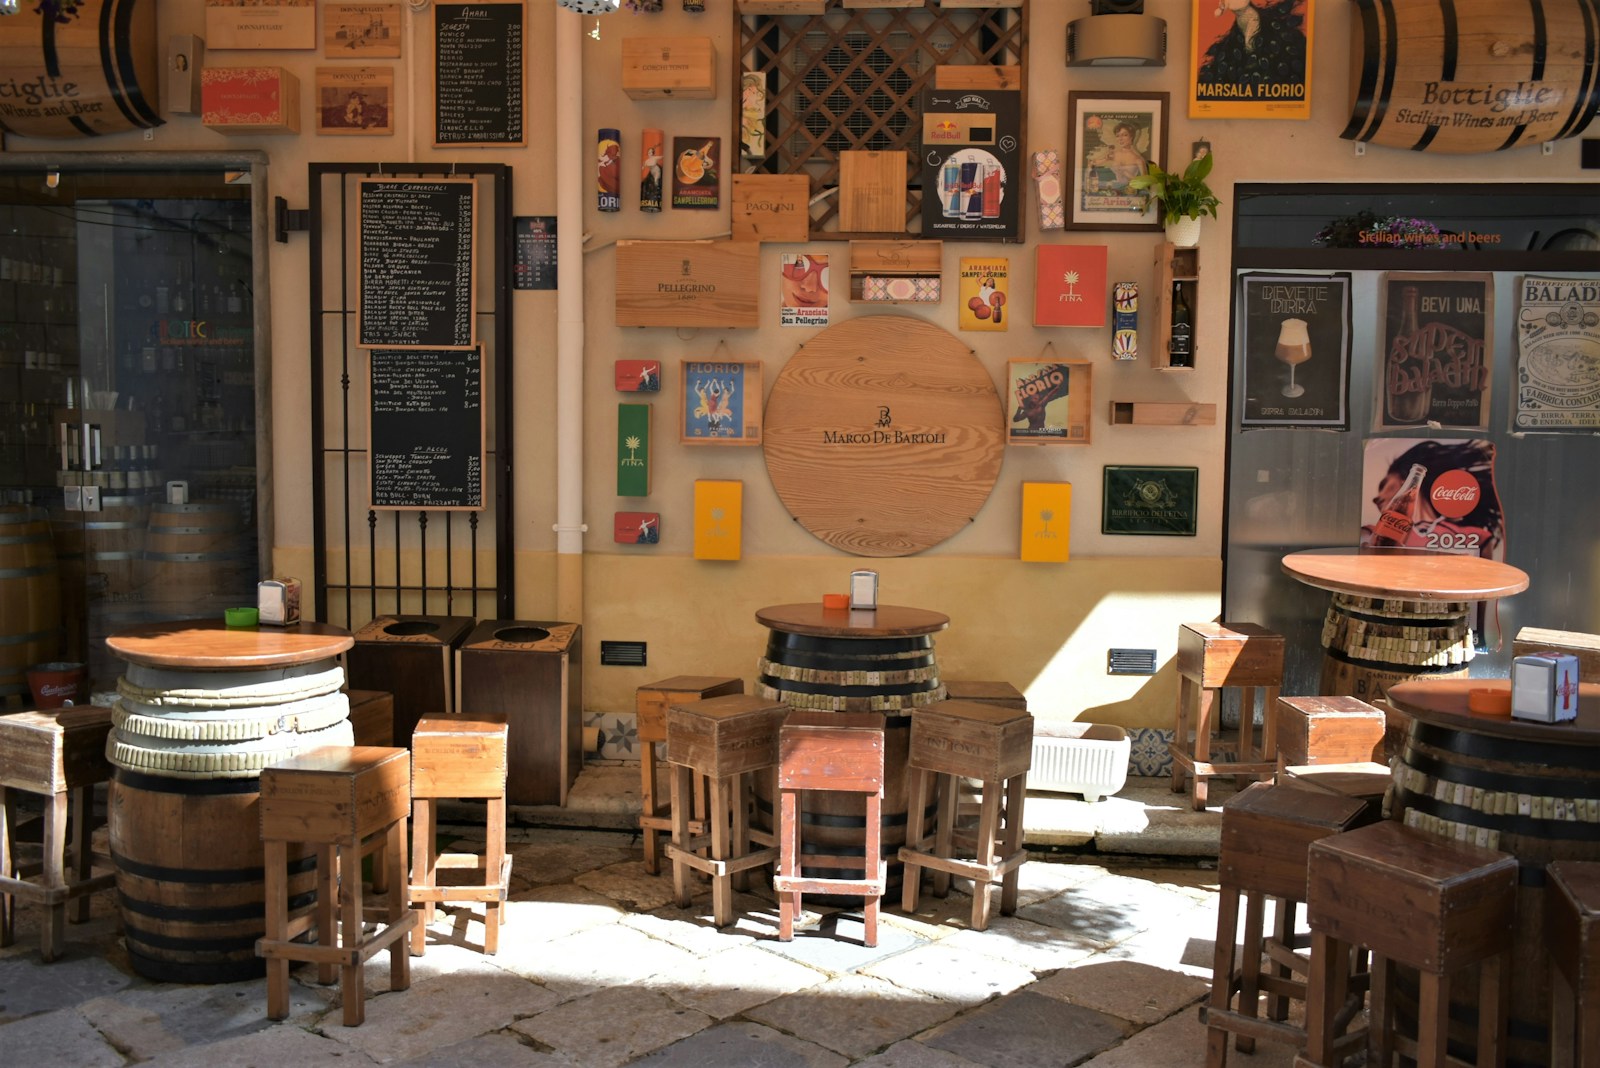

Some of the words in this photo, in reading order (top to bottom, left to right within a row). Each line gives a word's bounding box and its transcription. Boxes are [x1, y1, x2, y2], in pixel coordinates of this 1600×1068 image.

[462, 6, 488, 19] AMARI
[441, 23, 470, 31] SEGESTA
[1198, 83, 1253, 97] MARSALA
[1258, 83, 1304, 97] FLORIO
[1422, 81, 1554, 112] Bottiglie
[43, 100, 70, 116] and
[71, 100, 102, 114] Beer
[1396, 108, 1450, 126] Sicilian
[1453, 112, 1494, 128] Wines
[1498, 110, 1522, 126] and
[1526, 108, 1560, 125] Beer
[440, 132, 465, 140] PETRUS
[746, 202, 794, 212] PAOLINI
[1358, 230, 1402, 243] Sicilian
[1442, 230, 1465, 243] and
[1468, 230, 1501, 243] beers
[658, 283, 716, 293] PELLEGRINO
[797, 308, 828, 316] Aranciata
[1421, 297, 1450, 313] BEVI
[1456, 298, 1480, 314] UNA
[782, 316, 793, 324] San
[795, 316, 828, 326] Pellegrino
[690, 364, 740, 374] FLORIO
[1526, 389, 1564, 406] FABBRICA
[824, 431, 870, 443] MARCO
[874, 431, 891, 443] DE
[895, 431, 945, 444] BARTOLI
[1432, 486, 1478, 501] Coca-Cola
[1380, 512, 1412, 533] Coca-Cola
[1426, 534, 1480, 549] 2022
[1367, 671, 1402, 680] CANTINA
[1357, 680, 1400, 696] BA
